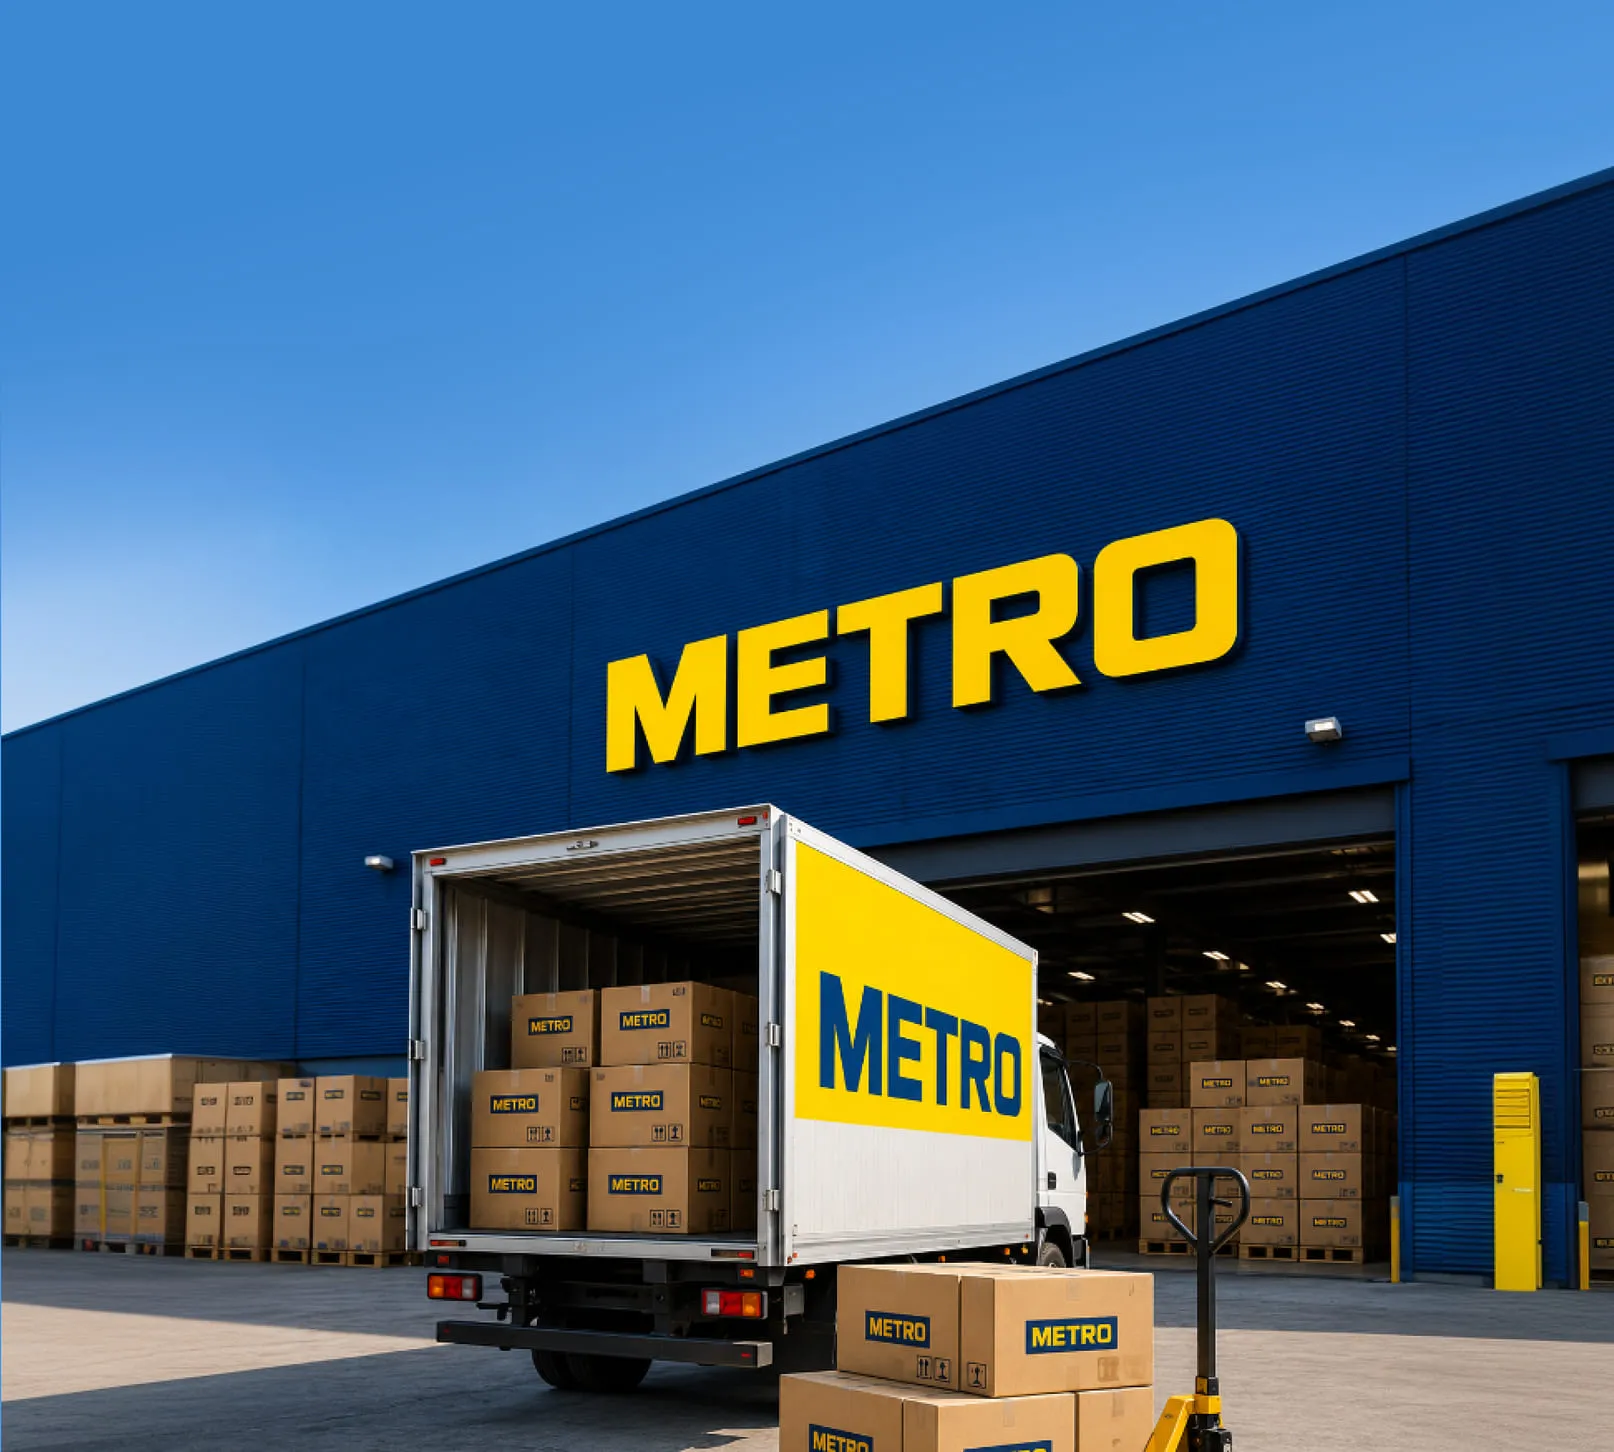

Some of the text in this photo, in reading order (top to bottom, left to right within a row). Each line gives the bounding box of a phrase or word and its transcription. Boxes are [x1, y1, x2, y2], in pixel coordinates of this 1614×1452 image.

[605, 517, 1238, 773] METRO
[530, 1018, 571, 1033] METRO
[622, 1013, 667, 1027] METRO
[820, 972, 1021, 1117] METRO
[493, 1098, 536, 1112] METRO
[614, 1094, 661, 1109] METRO
[1312, 1124, 1345, 1133] METRO
[491, 1177, 535, 1191] METRO
[611, 1177, 659, 1192] METRO
[869, 1316, 926, 1343] METRO
[1032, 1323, 1112, 1348] METRO
